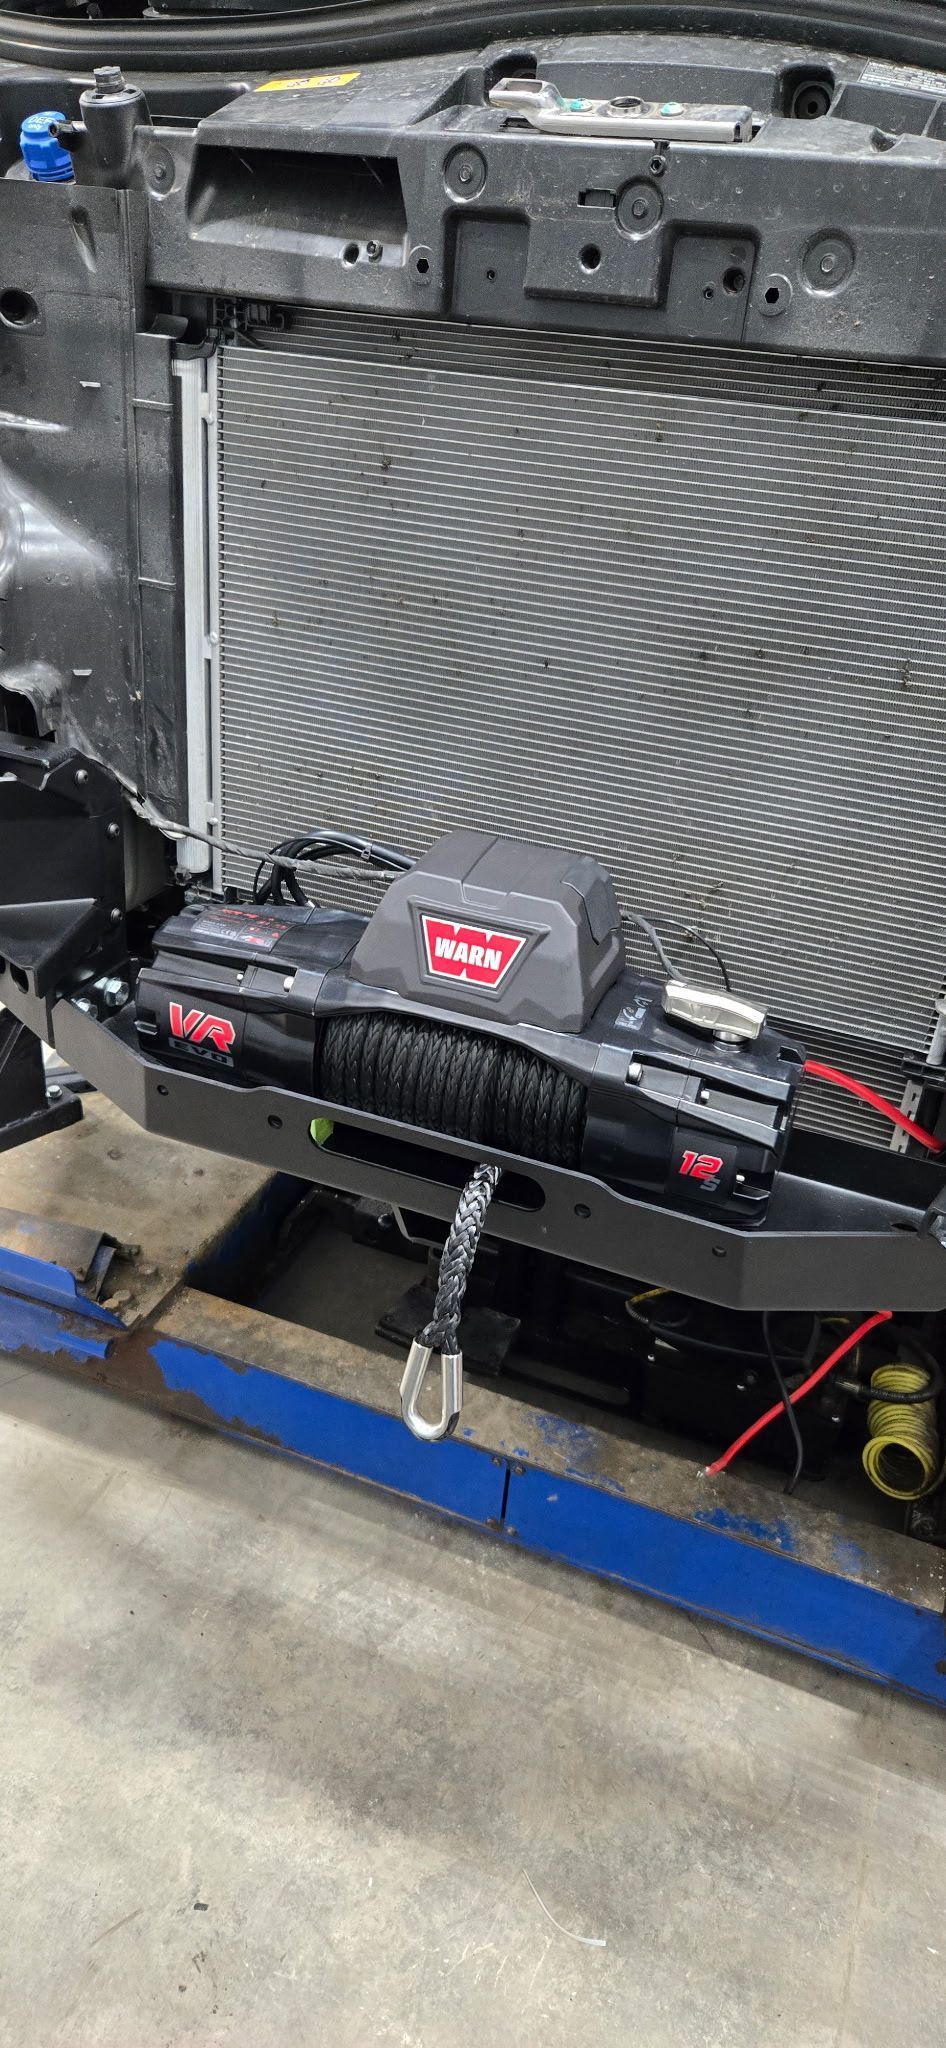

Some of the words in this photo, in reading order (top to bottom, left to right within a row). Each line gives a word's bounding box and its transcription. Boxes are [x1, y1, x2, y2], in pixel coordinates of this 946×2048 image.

[434, 936, 502, 971] WARN
[169, 1002, 236, 1053] VR
[173, 1040, 228, 1064] EVO
[679, 1150, 724, 1180] 12
